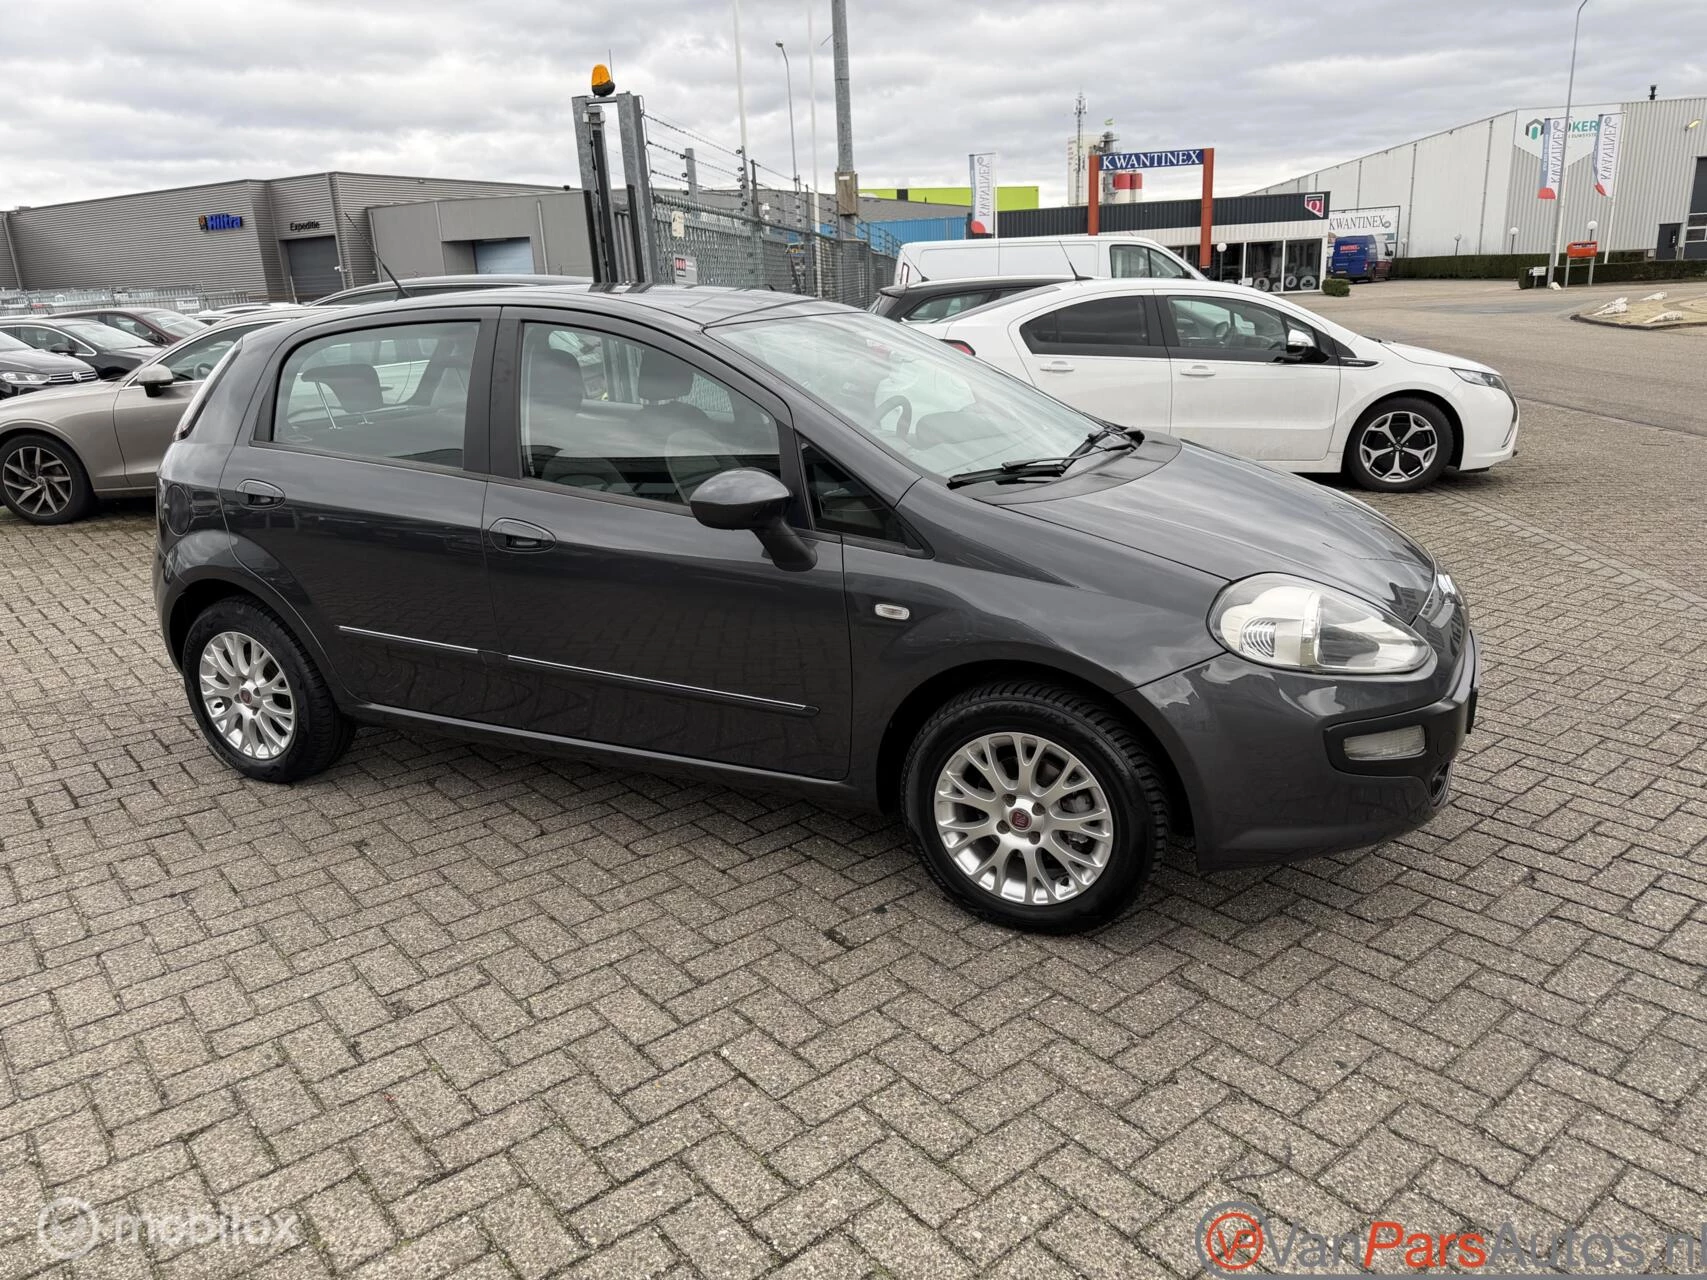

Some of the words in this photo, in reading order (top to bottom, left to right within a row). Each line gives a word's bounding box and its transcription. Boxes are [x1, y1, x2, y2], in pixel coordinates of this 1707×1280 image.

[1102, 150, 1200, 170] KWANTINEX
[207, 212, 242, 231] Hiltra
[1329, 214, 1385, 231] KWANTINEX
